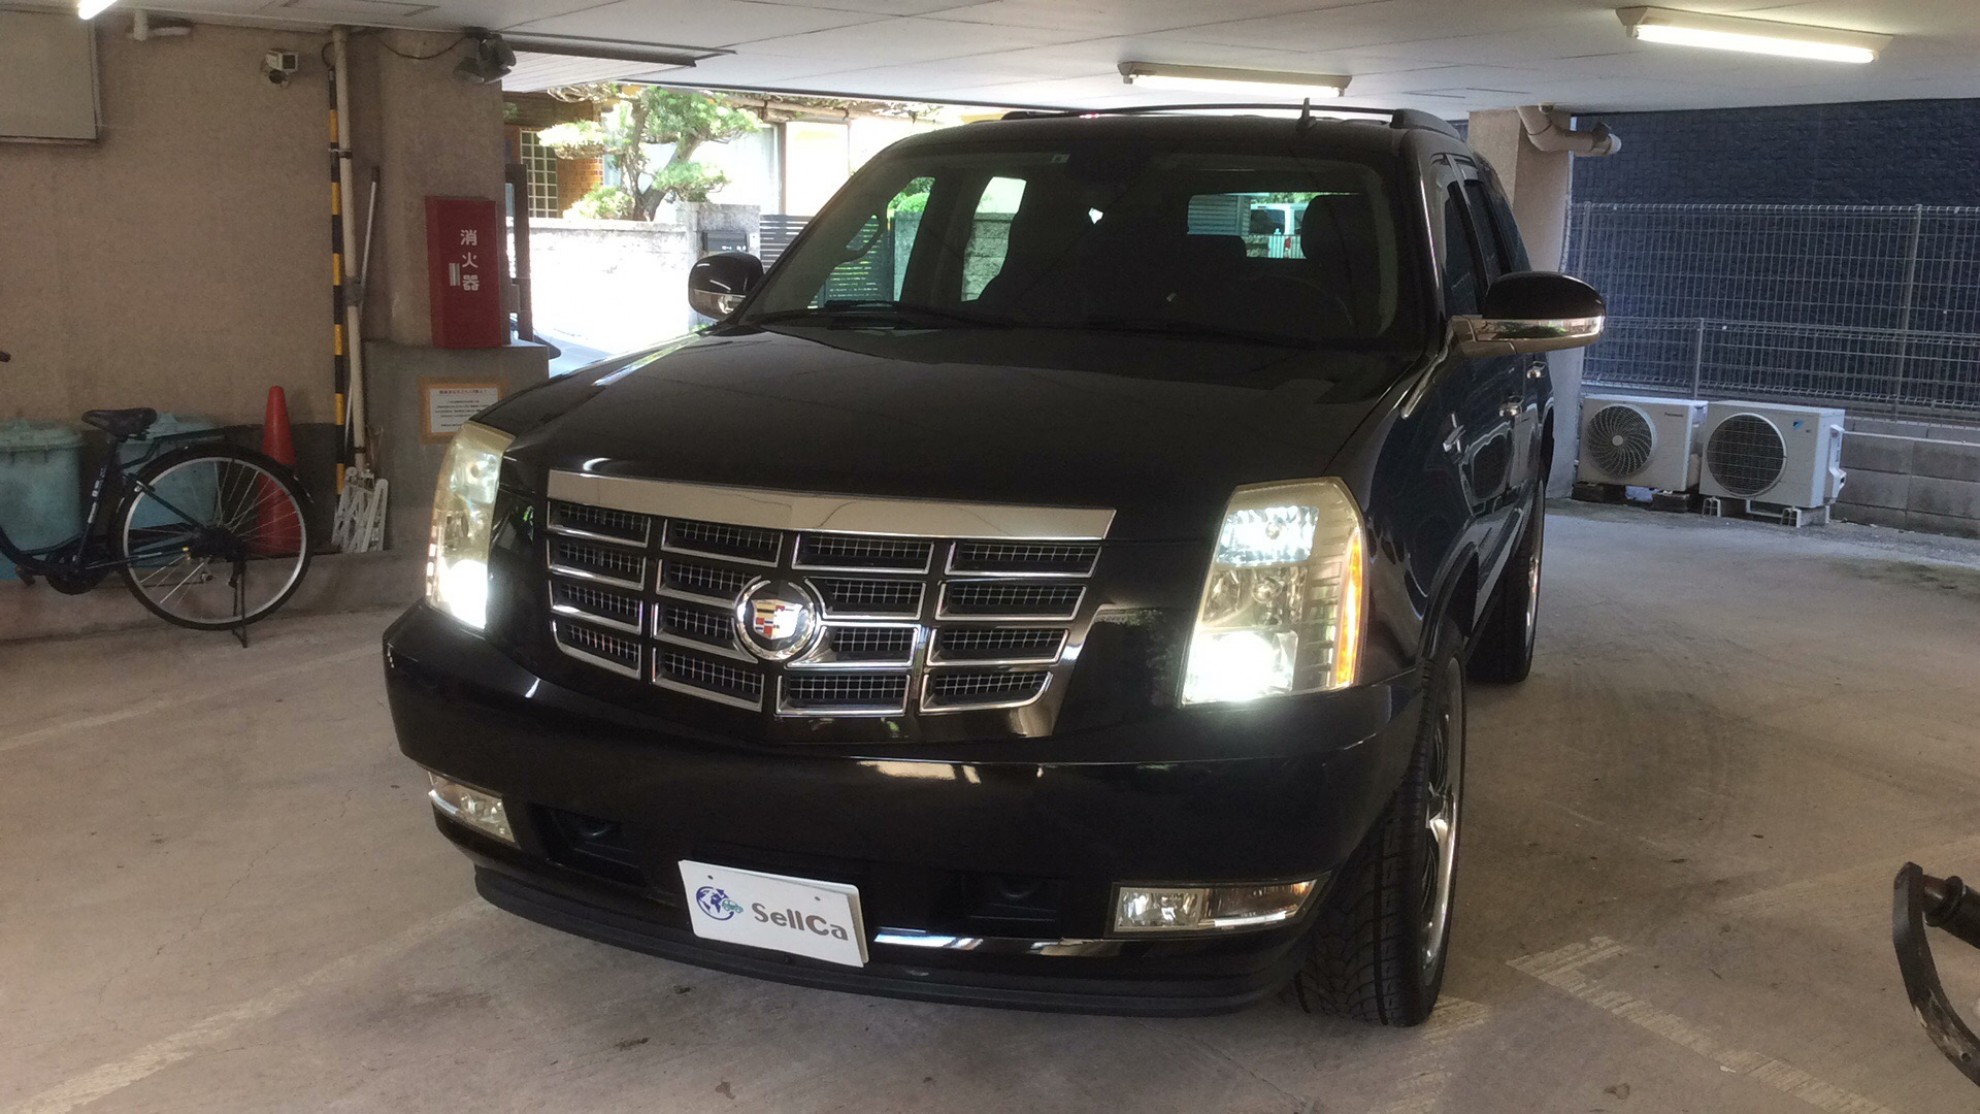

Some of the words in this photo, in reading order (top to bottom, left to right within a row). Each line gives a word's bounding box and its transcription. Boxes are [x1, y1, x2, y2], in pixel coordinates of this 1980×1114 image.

[460, 229, 479, 291] 消火器
[751, 902, 849, 941] SellCa
